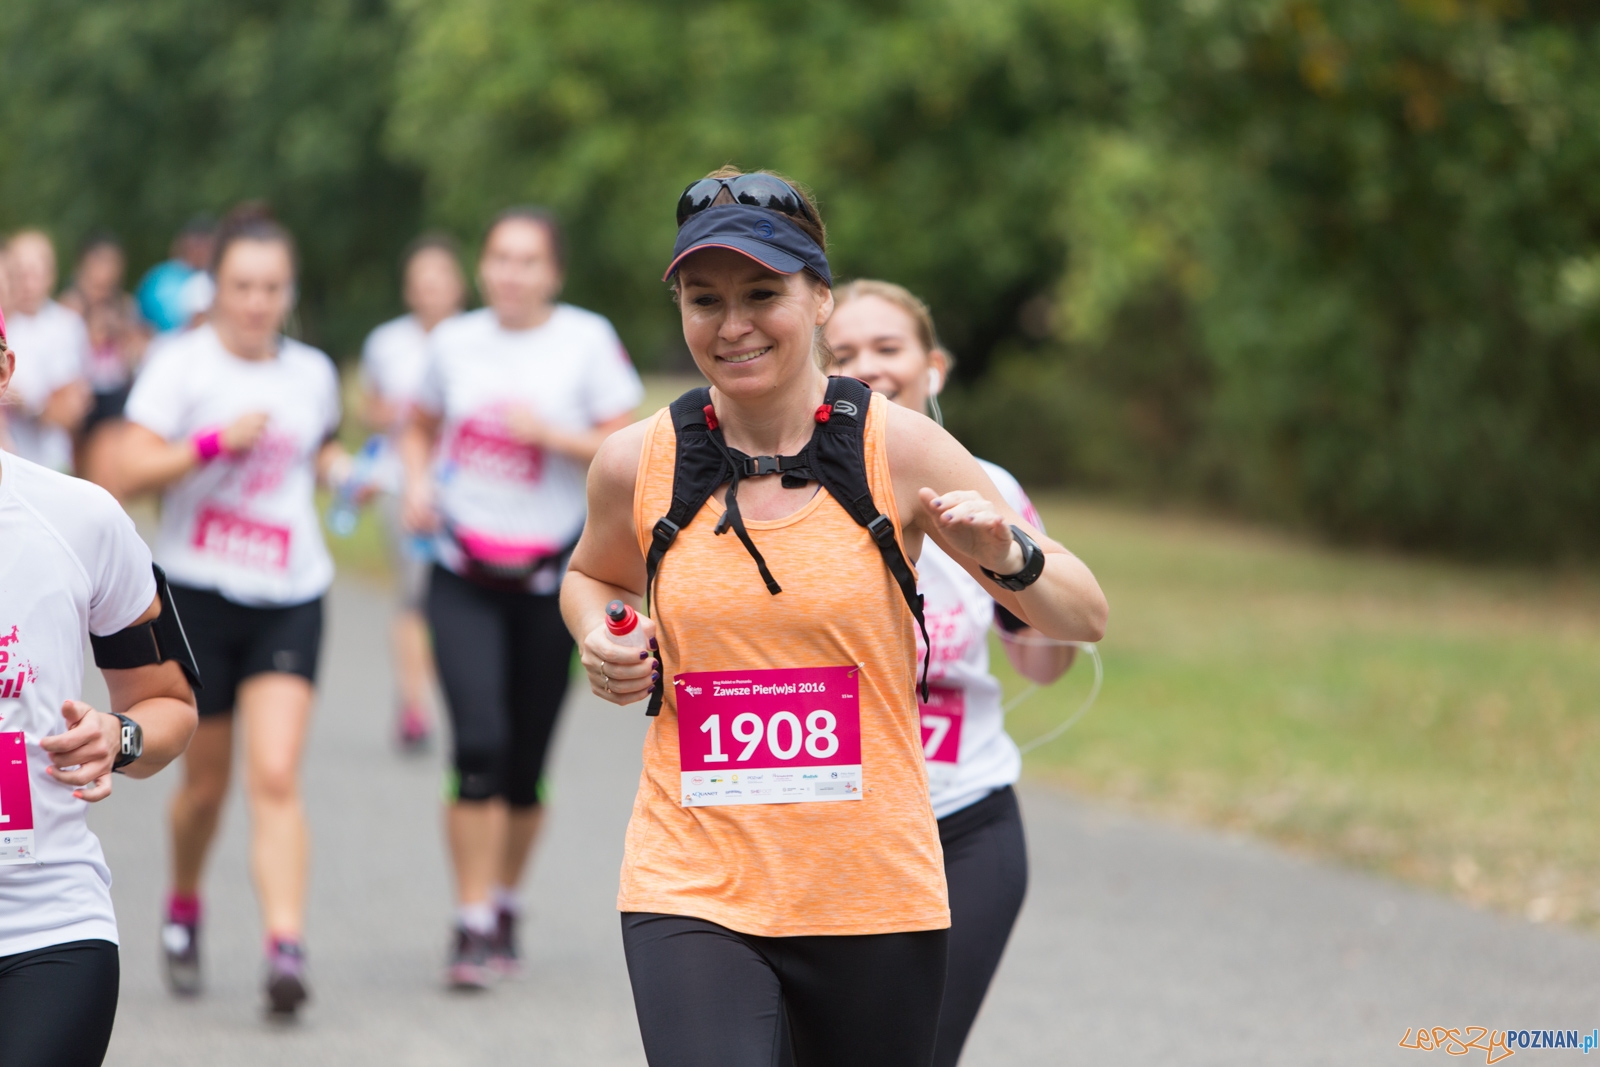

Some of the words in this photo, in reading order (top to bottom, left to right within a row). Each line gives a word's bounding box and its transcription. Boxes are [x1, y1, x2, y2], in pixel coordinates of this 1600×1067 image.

[713, 686, 750, 697] Zawsze
[752, 683, 797, 696] Pier(w)si
[798, 682, 826, 693] 2016
[699, 709, 840, 763] 1908
[921, 714, 952, 760] 7
